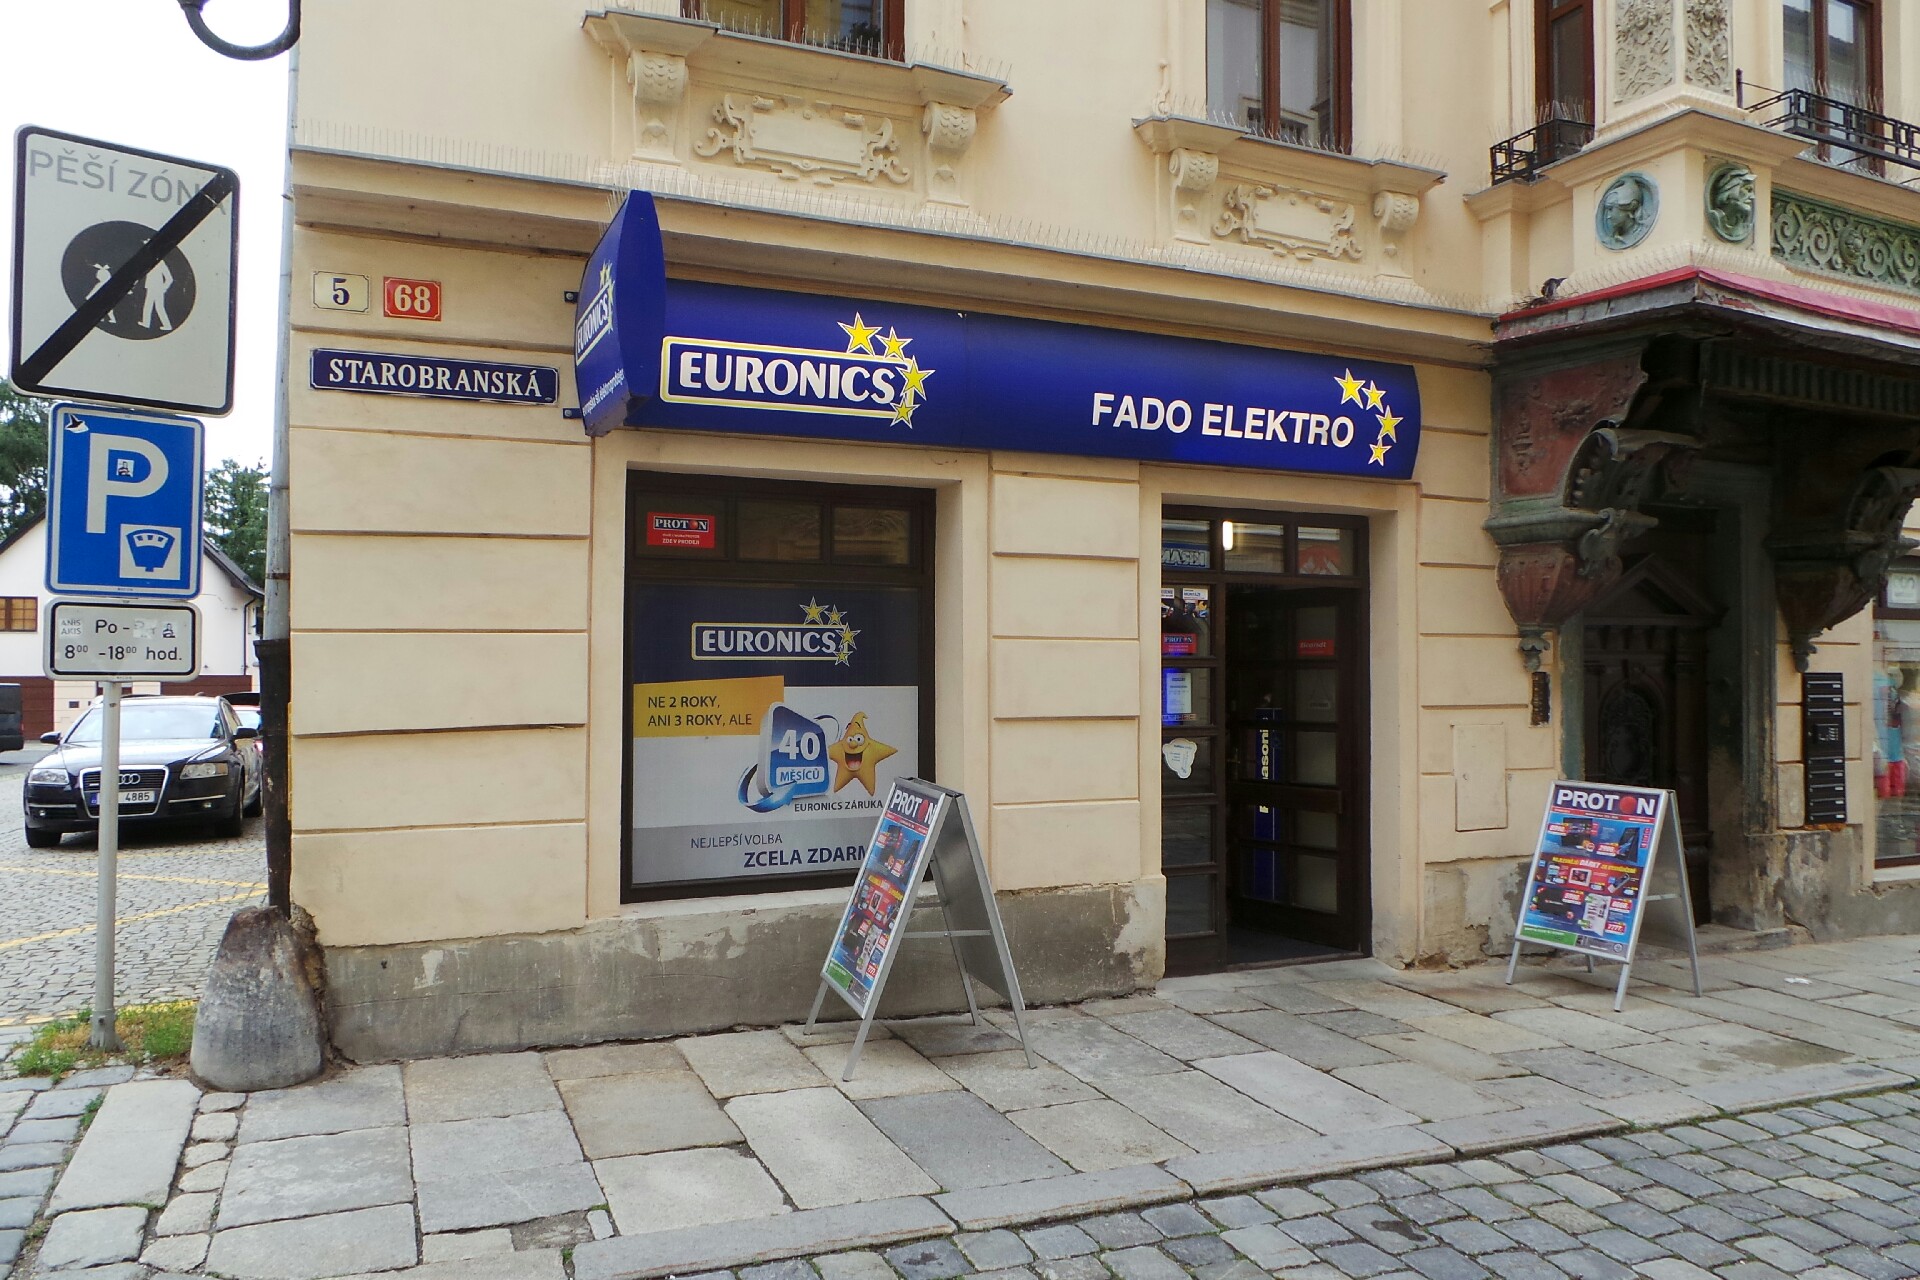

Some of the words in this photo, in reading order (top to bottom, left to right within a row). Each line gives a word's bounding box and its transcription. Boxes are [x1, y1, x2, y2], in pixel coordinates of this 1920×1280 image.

[29, 148, 118, 193] PĚŠÍ
[127, 169, 226, 215] ZÓN
[332, 277, 350, 306] 5
[394, 284, 431, 314] 68
[577, 293, 608, 352] EURONICS
[329, 358, 542, 397] STAROBRANSKÁ
[680, 351, 896, 404] EURONICS
[1092, 392, 1193, 434] FADO
[1202, 402, 1355, 448] ELEKTRO
[86, 433, 169, 534] P
[655, 518, 707, 530] PROTON
[146, 646, 182, 661] hod.
[702, 630, 836, 654] EURONICS
[648, 697, 665, 708] NE
[669, 697, 677, 708] 2
[681, 696, 720, 709] ROKY,
[648, 715, 671, 727] ANI
[674, 715, 682, 726] 3
[686, 714, 726, 727] ROKY,
[729, 713, 752, 726] ALE
[778, 729, 821, 761] 40
[780, 767, 820, 782] MĚSÍCŮ
[125, 792, 150, 802] 4885
[794, 802, 843, 813] EURONICS
[844, 799, 884, 810] ZÁRUKA
[891, 790, 939, 824] PROTON
[1556, 789, 1656, 816] PROTON
[690, 833, 742, 849] NEJLEPŠÍ
[745, 834, 783, 847] VOLBA
[743, 850, 802, 868] ZCELA
[807, 845, 866, 864] ZDARM
